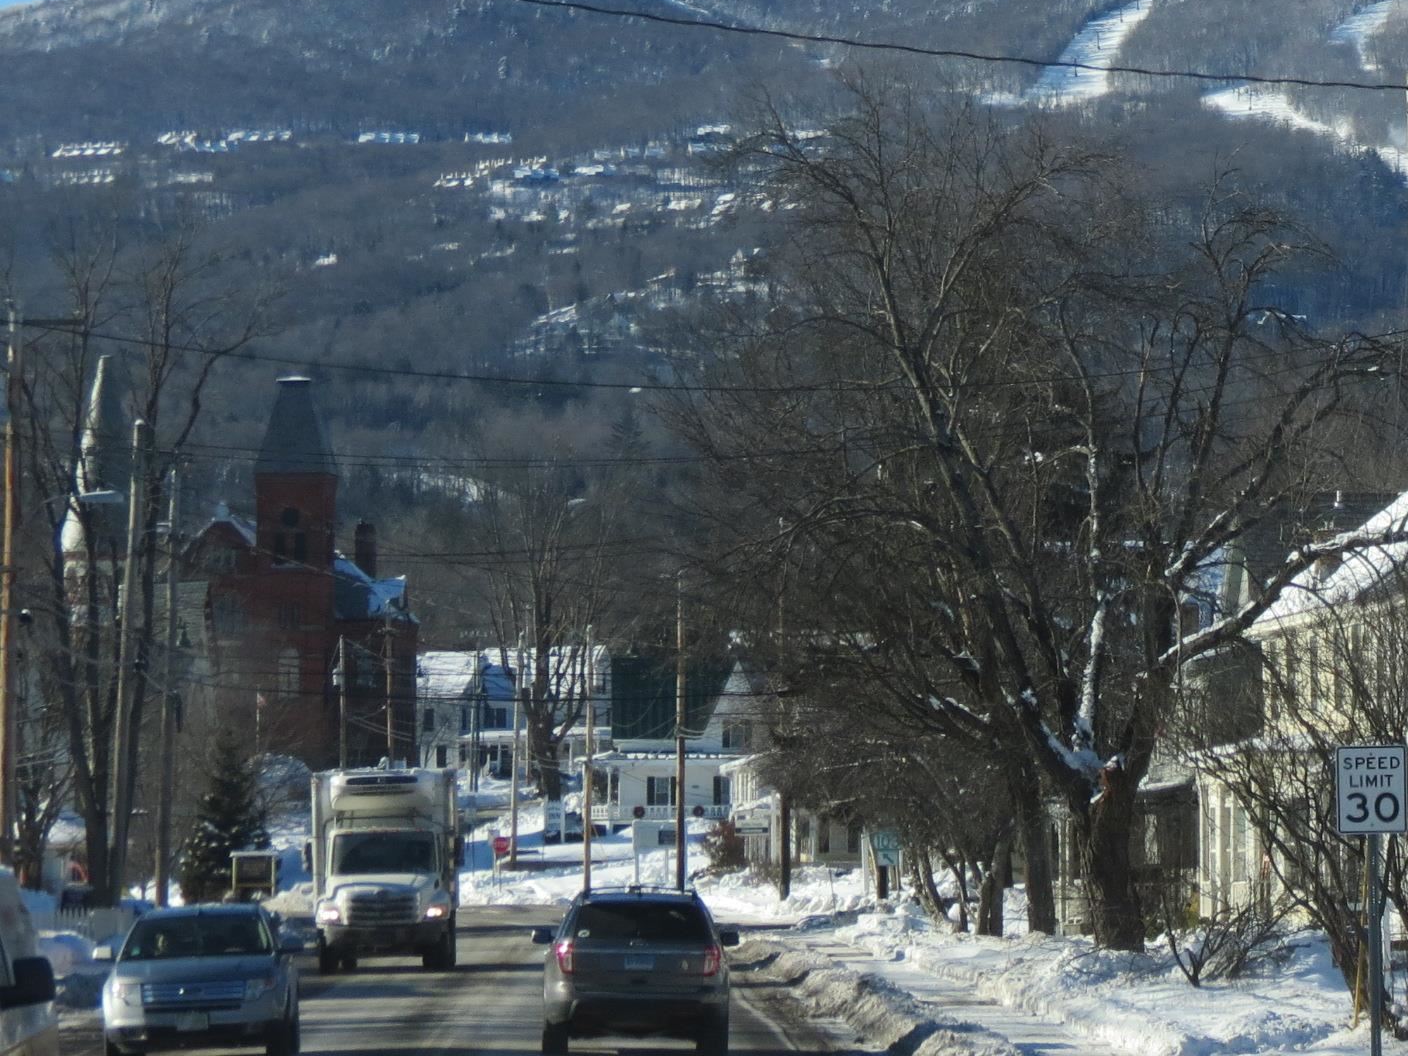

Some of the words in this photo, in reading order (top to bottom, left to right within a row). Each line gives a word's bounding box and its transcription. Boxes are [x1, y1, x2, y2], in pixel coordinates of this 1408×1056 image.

[1343, 756, 1400, 770] SPEED
[1349, 774, 1394, 788] LIMIT
[1346, 792, 1400, 823] 30
